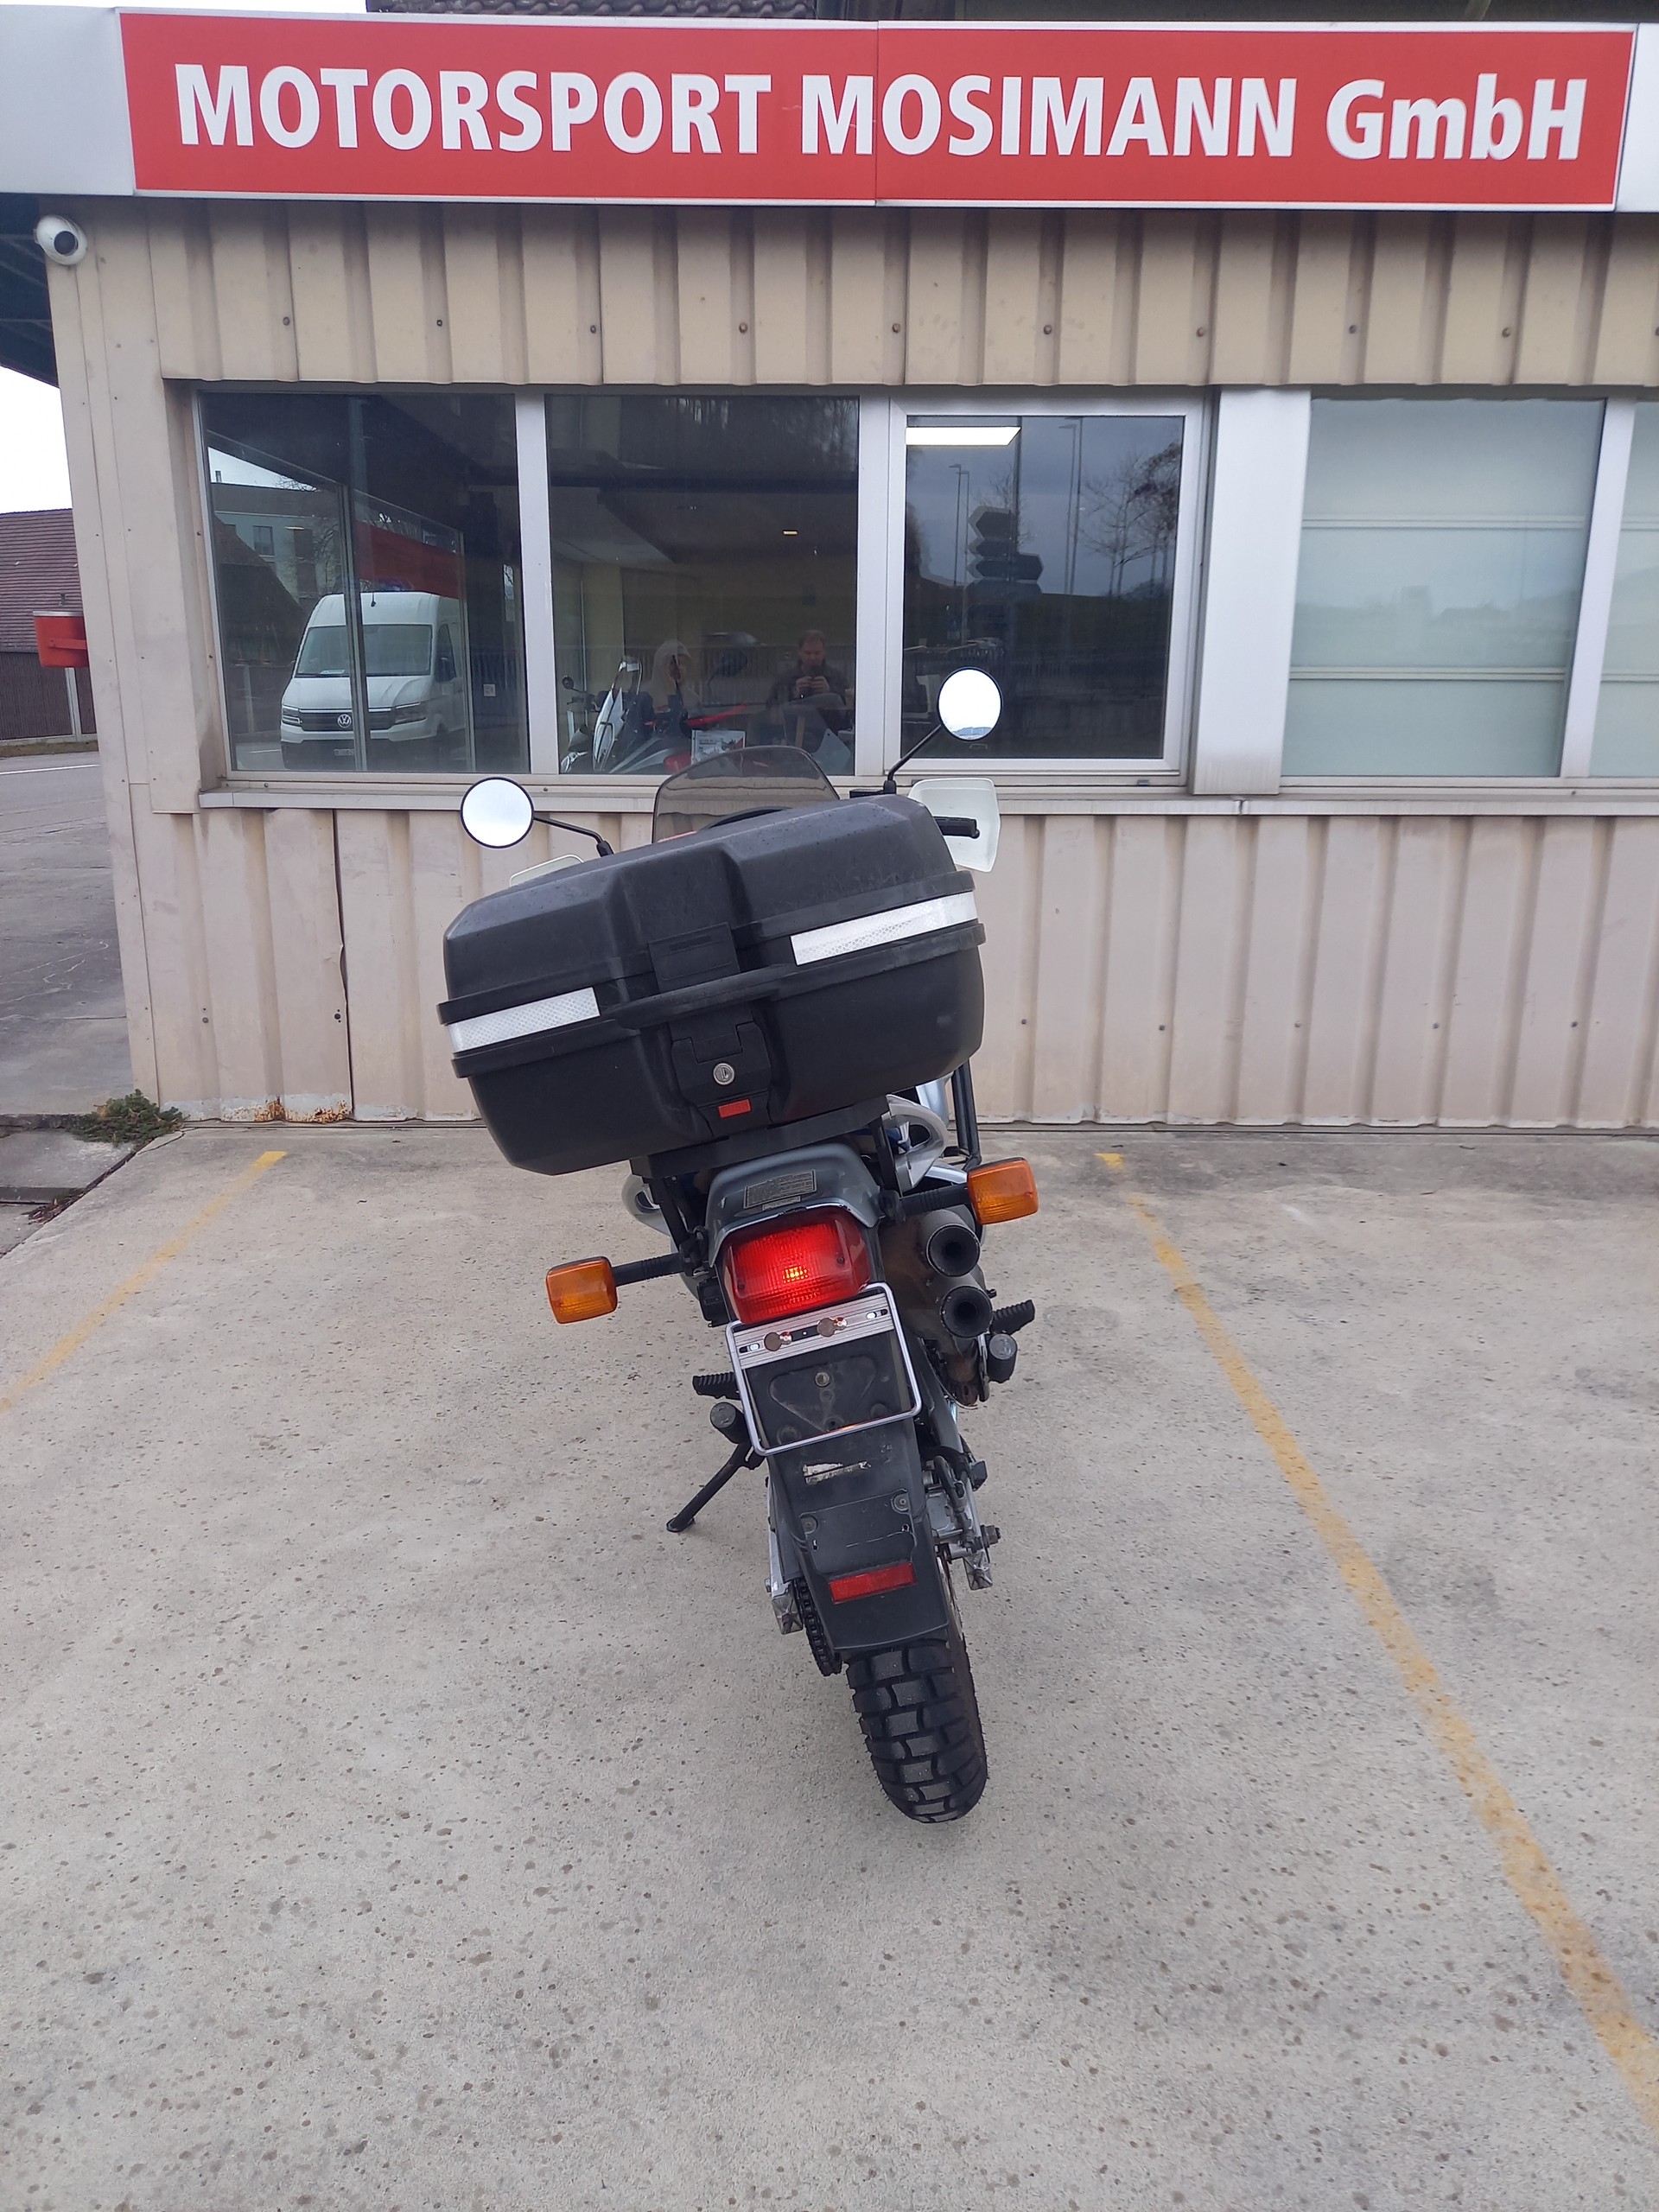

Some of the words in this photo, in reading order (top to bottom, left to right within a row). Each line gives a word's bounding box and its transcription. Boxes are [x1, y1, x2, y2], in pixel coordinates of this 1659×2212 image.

[175, 63, 772, 156] MOTORSPORT
[802, 73, 1297, 157] MOSIMANN
[1326, 73, 1588, 162] GmbH
